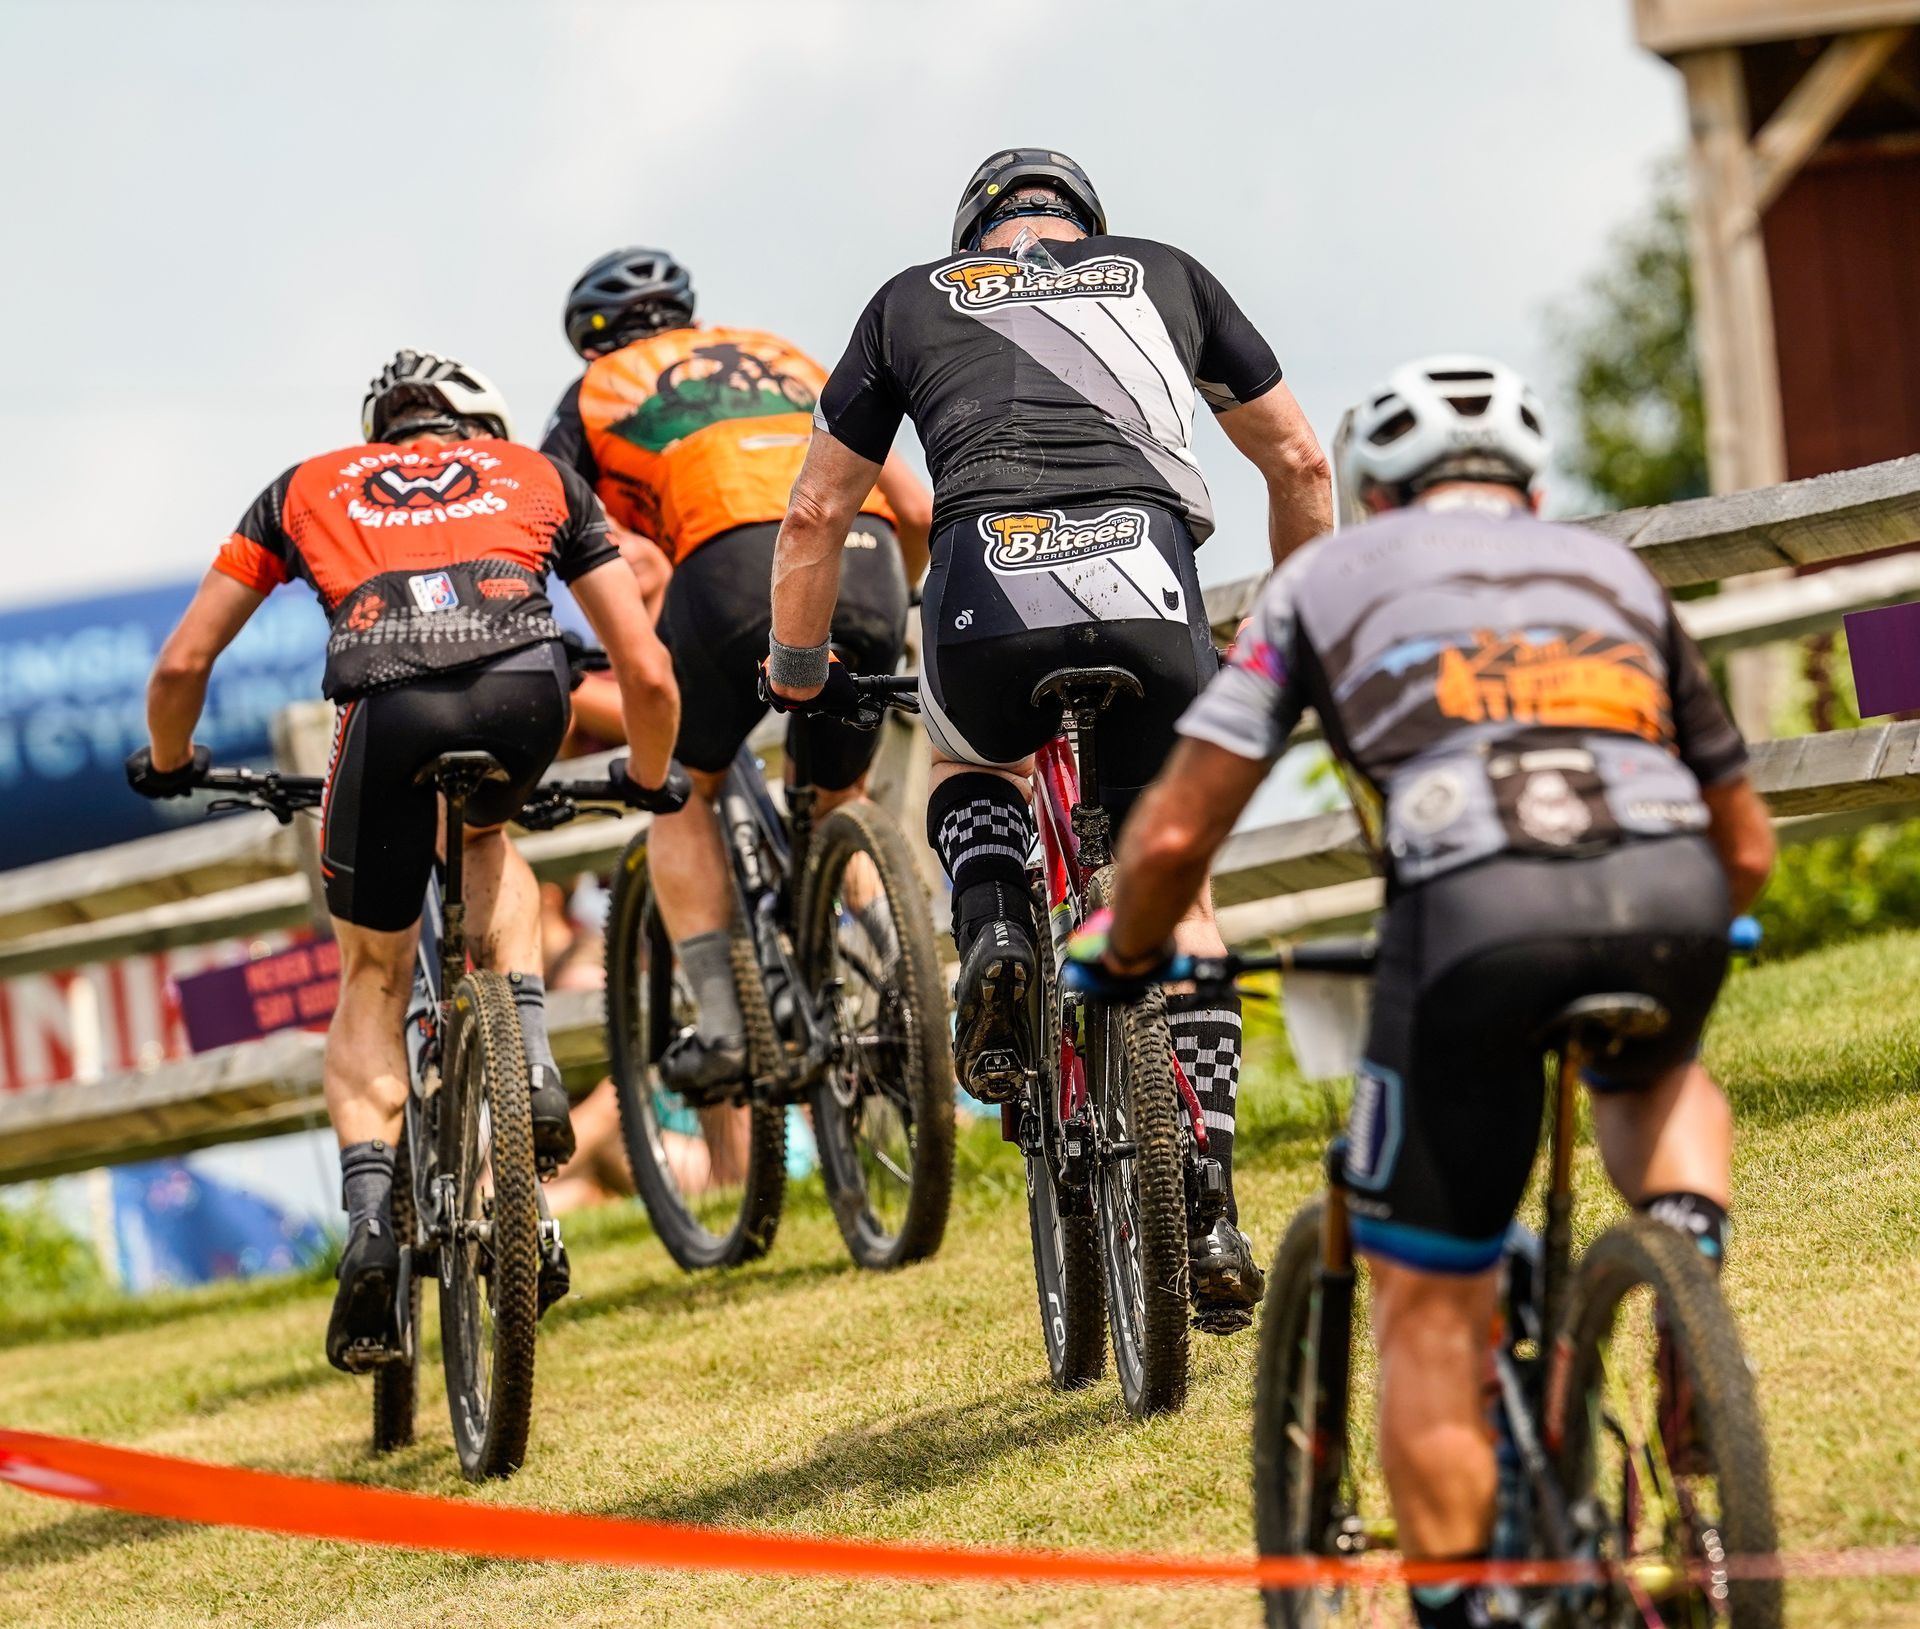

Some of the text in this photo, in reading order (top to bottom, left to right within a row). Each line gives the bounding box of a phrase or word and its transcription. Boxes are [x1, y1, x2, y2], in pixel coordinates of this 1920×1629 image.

[1011, 284, 1123, 298] SCREEN GRAPHIX
[347, 491, 508, 528] WARRIORS
[1036, 537, 1131, 561] SCREEN GRAPHIX
